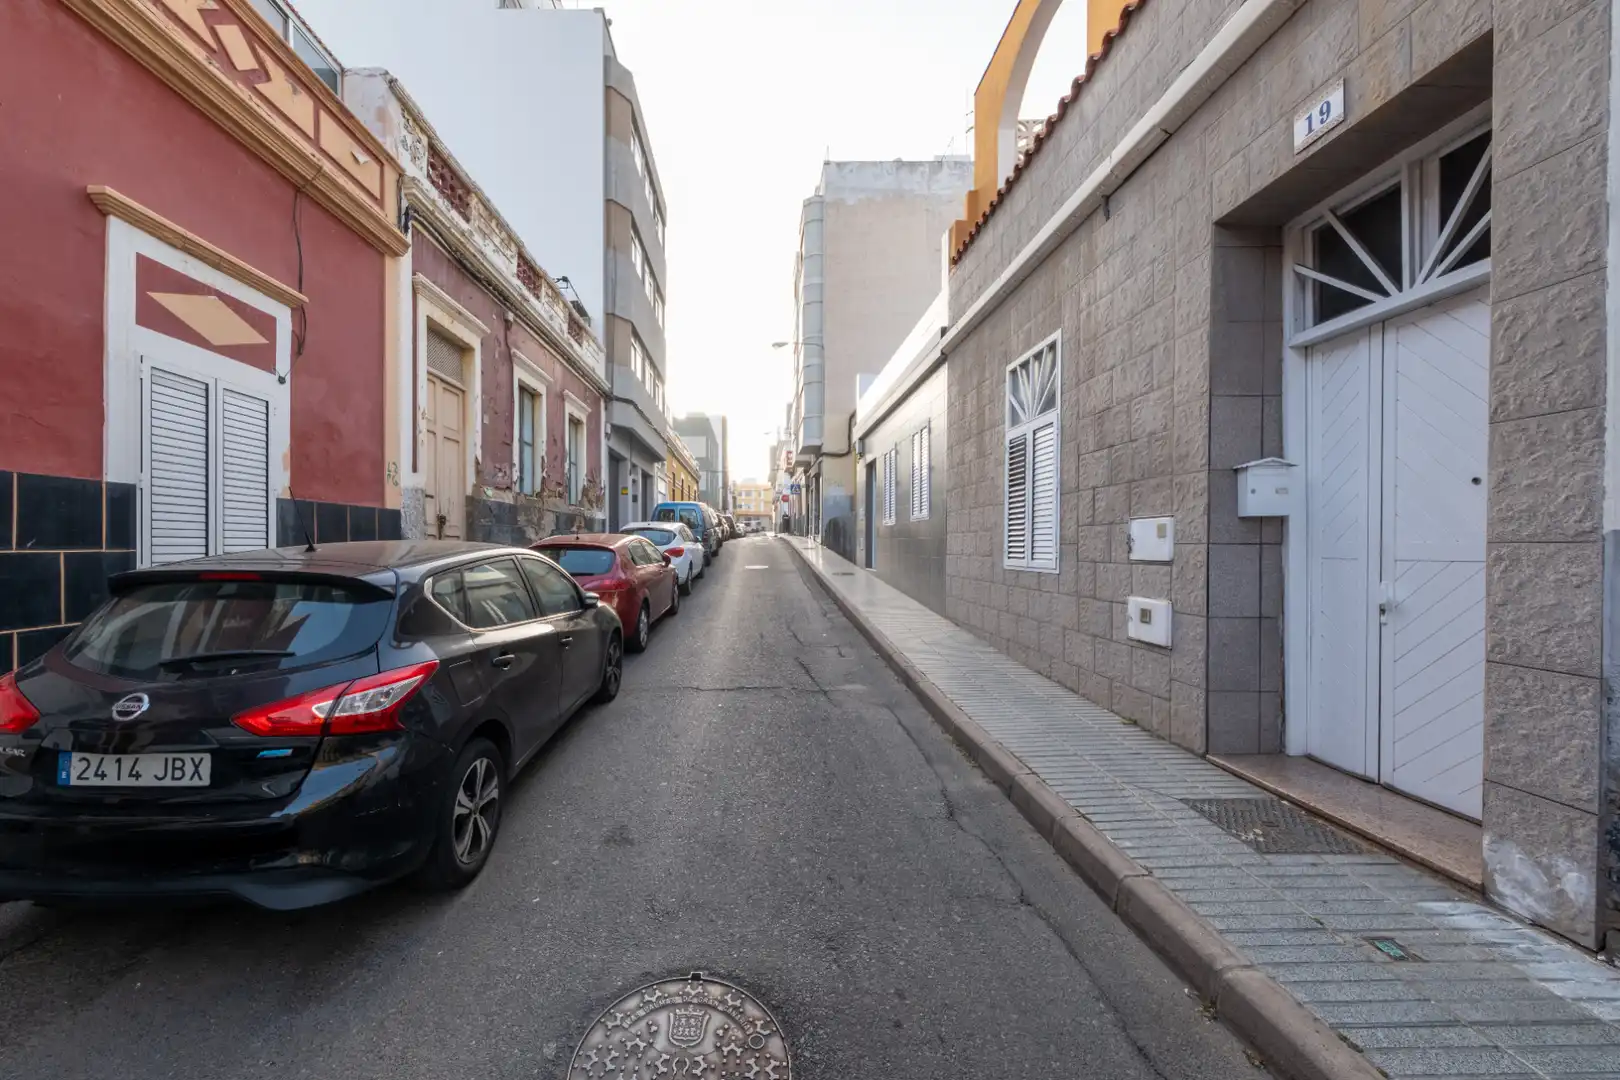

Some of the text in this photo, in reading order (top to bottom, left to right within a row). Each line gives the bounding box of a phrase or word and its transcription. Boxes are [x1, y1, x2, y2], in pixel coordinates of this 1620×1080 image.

[1305, 100, 1331, 137] 19
[76, 757, 204, 781] 2414 JBX
